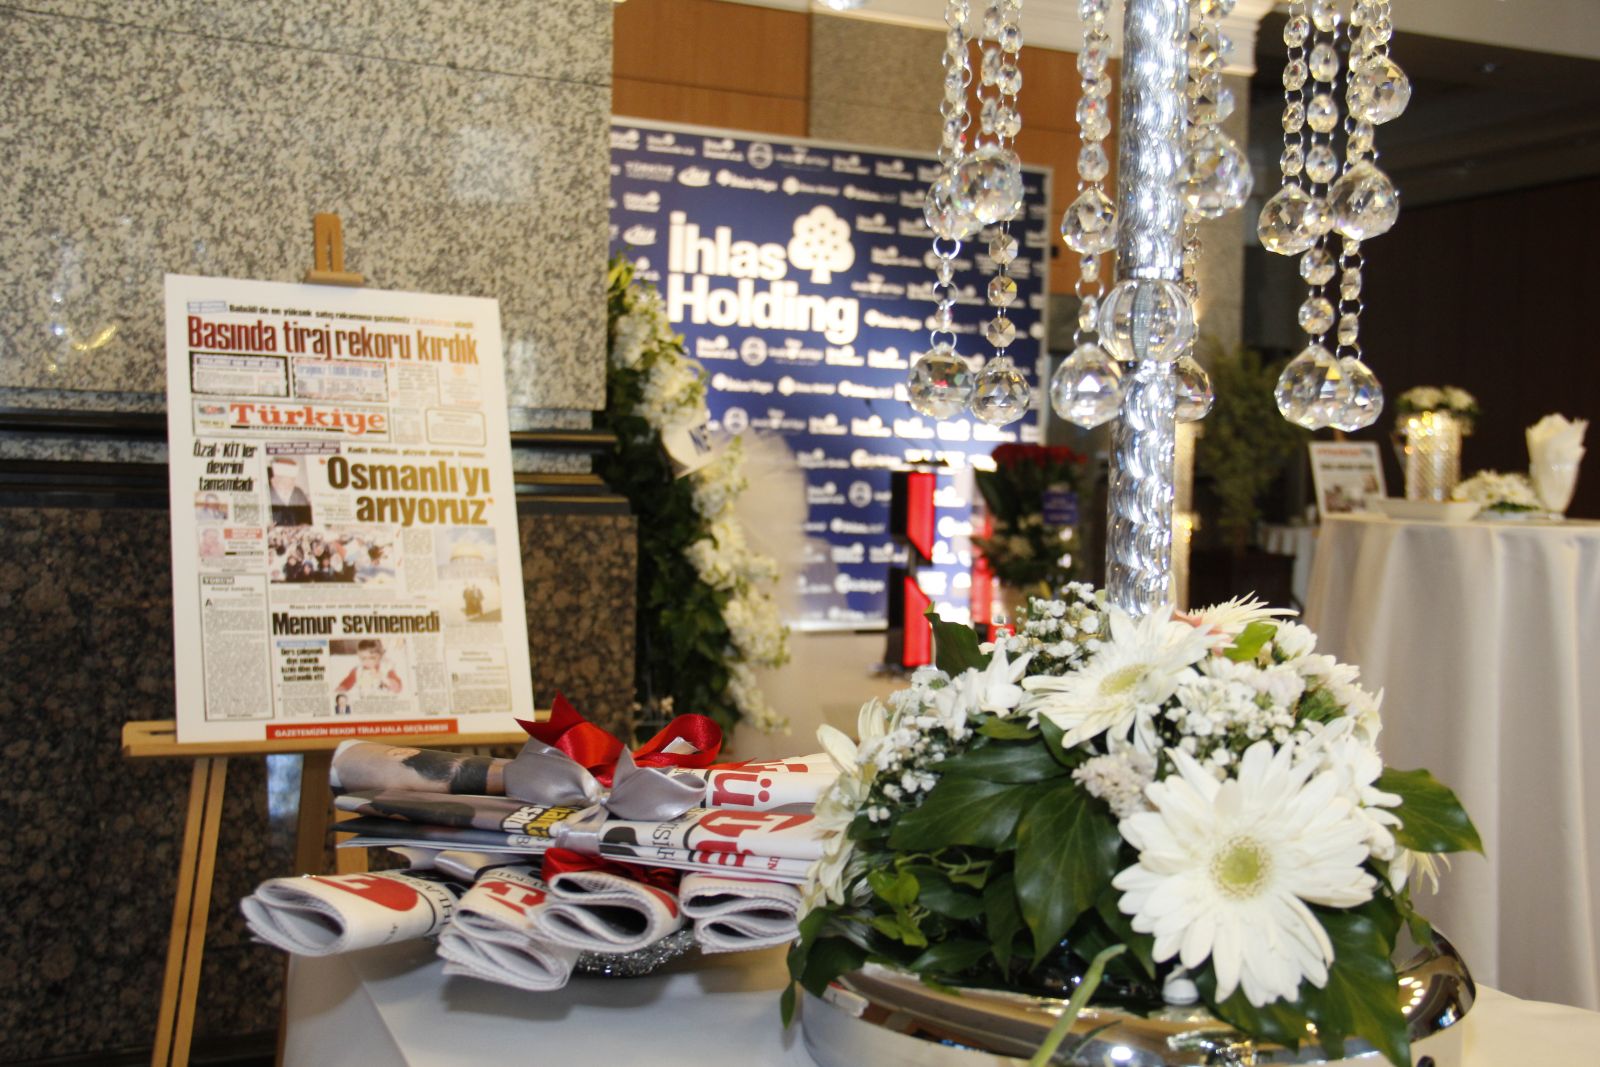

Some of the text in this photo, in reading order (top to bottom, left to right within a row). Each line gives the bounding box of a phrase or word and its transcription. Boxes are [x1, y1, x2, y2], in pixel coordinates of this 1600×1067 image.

[667, 272, 859, 345] Holding
[188, 315, 479, 365] Basında tiraj rekoru kırdık
[230, 403, 385, 435] Türkiye
[206, 459, 244, 475] devrini
[272, 610, 440, 635] Memur sevinemedi
